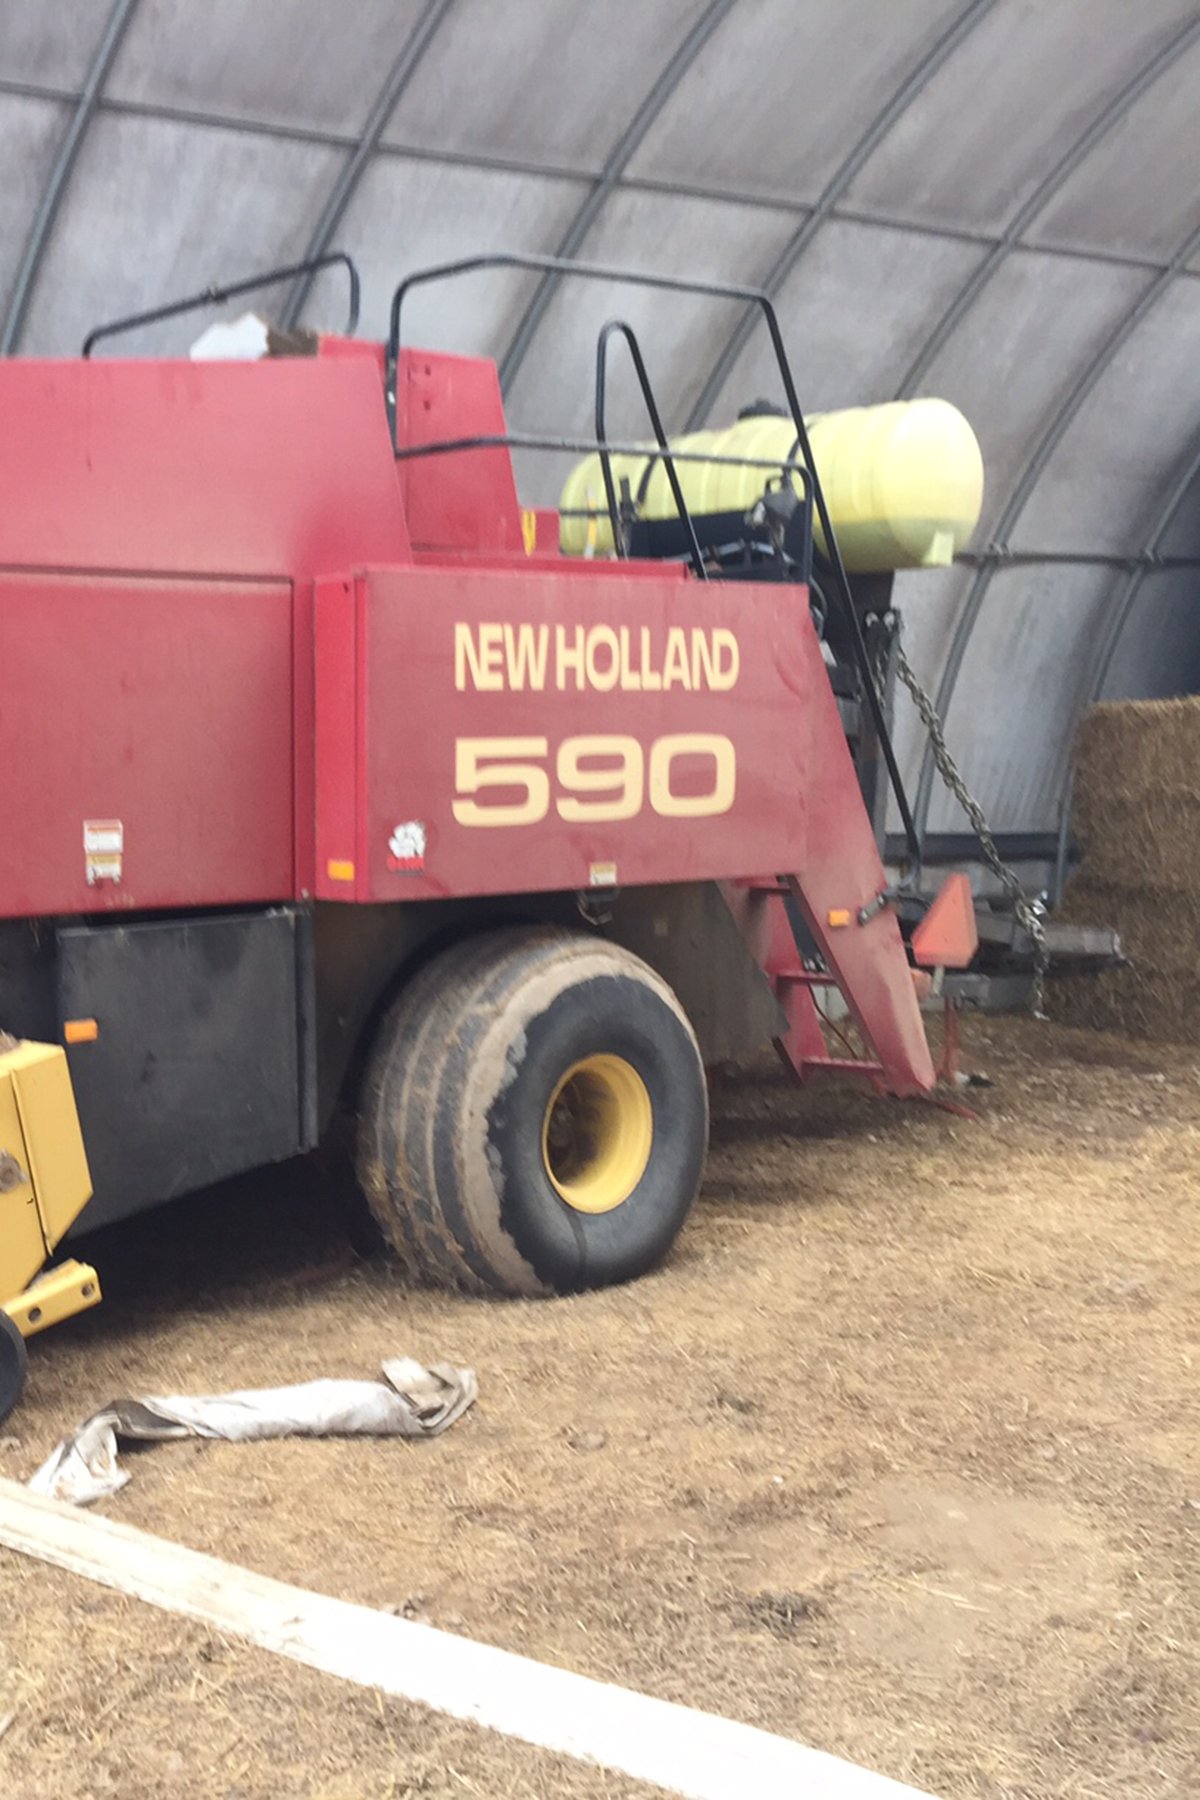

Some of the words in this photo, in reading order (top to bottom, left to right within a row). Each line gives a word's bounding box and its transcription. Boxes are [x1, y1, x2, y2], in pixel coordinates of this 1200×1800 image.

[454, 622, 549, 691] NEW
[556, 623, 740, 692] HOLLAND
[451, 732, 737, 827] 590
